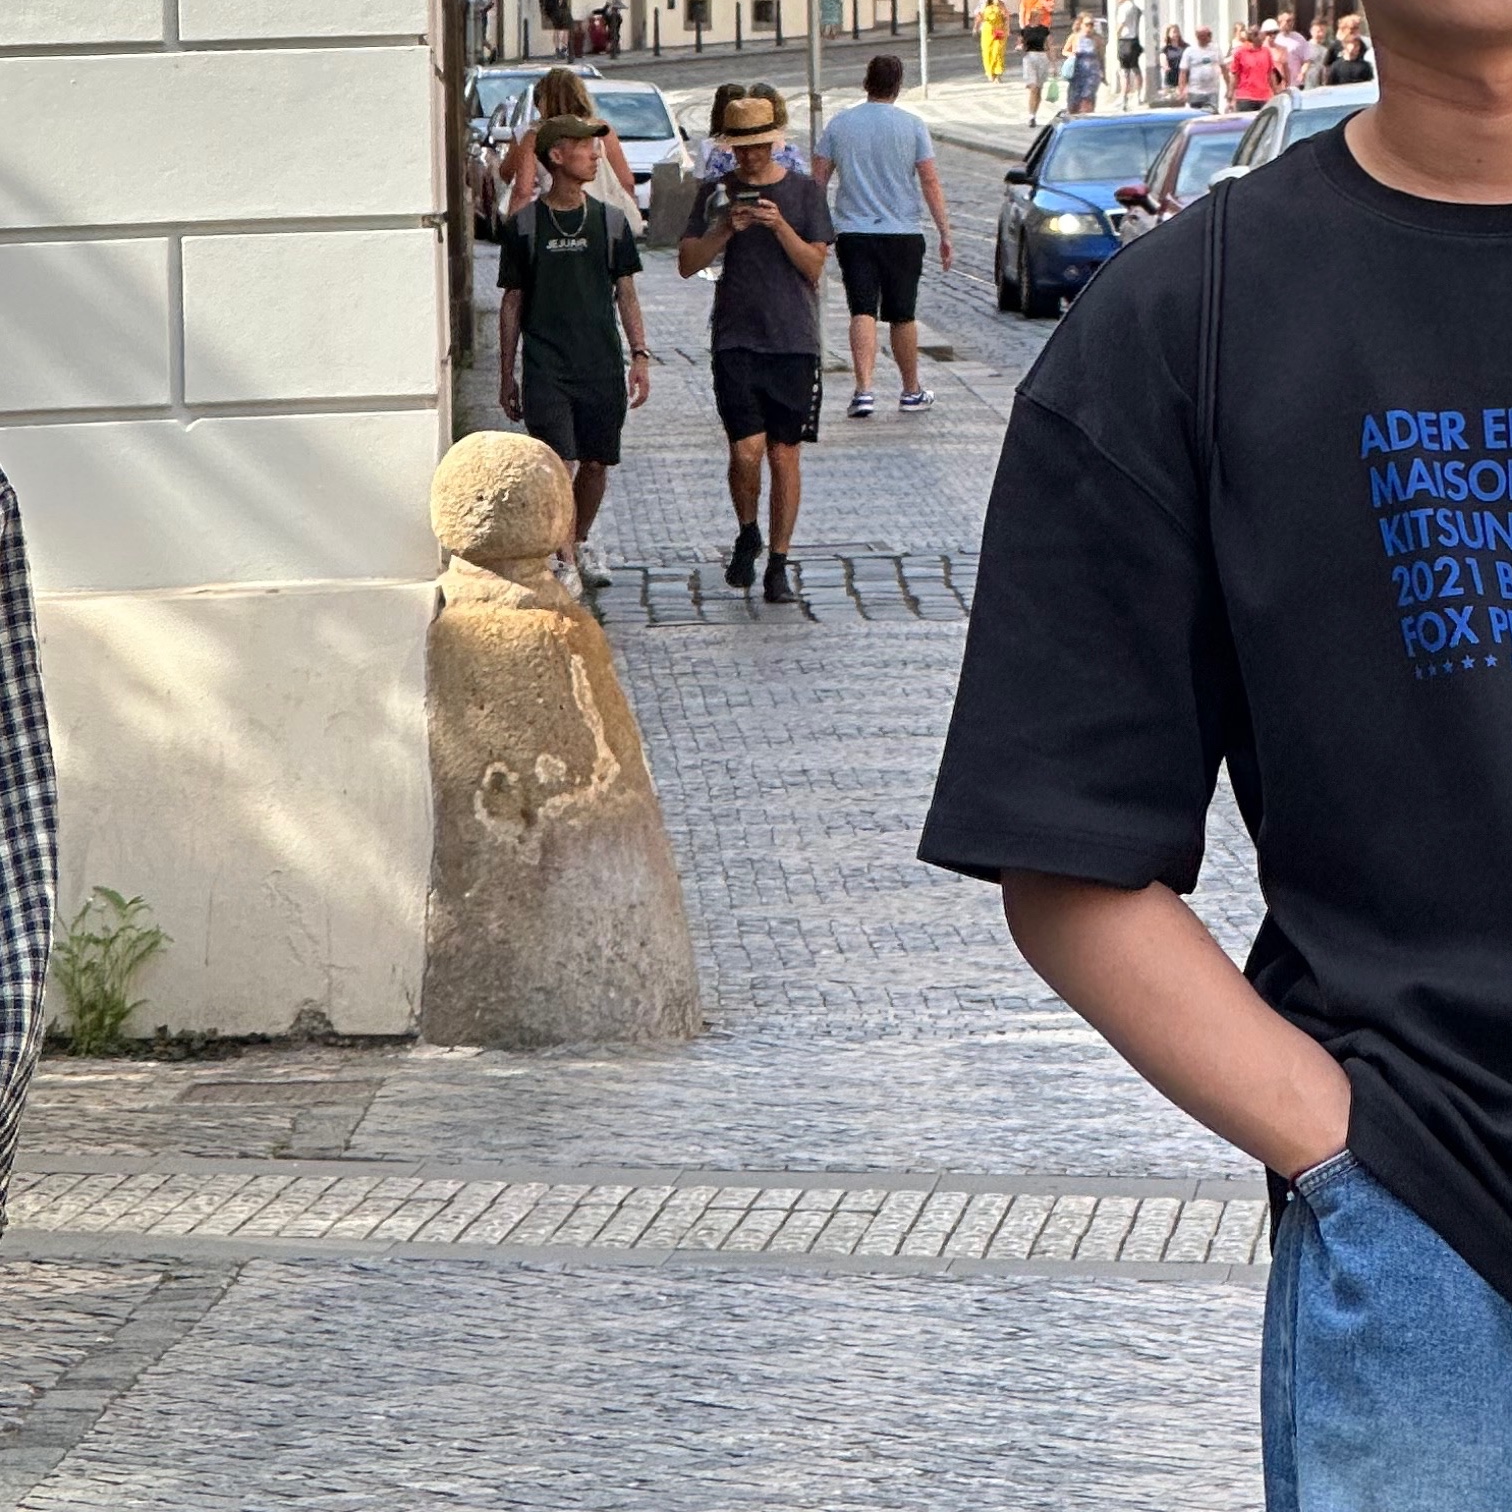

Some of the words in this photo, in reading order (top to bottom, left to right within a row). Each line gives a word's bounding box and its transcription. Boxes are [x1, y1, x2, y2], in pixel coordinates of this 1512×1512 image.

[1361, 409, 1470, 459] ADER
[1392, 555, 1485, 607] 2021
[1401, 605, 1480, 658] FOX
